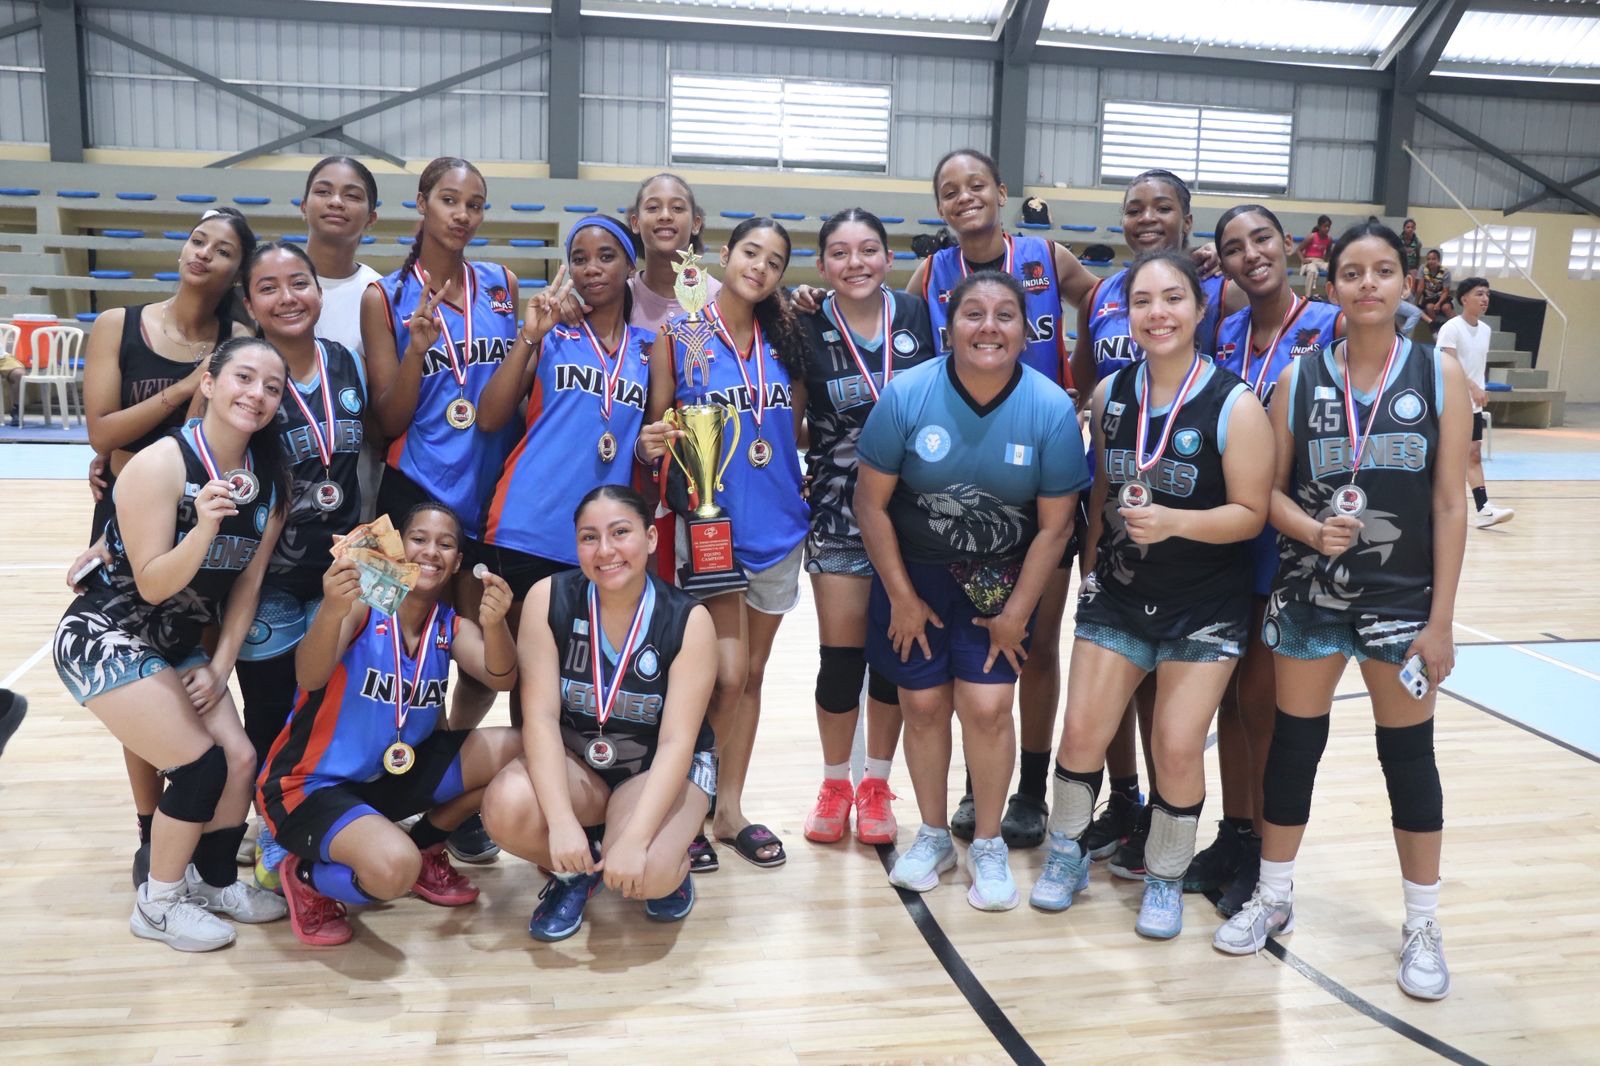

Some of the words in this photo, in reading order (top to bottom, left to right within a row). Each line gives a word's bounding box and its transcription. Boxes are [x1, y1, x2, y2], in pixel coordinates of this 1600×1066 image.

[1022, 277, 1050, 288] INDIAS
[827, 345, 849, 372] 11
[554, 363, 649, 413] INDIA
[1308, 402, 1341, 433] 45
[565, 638, 590, 673] 10
